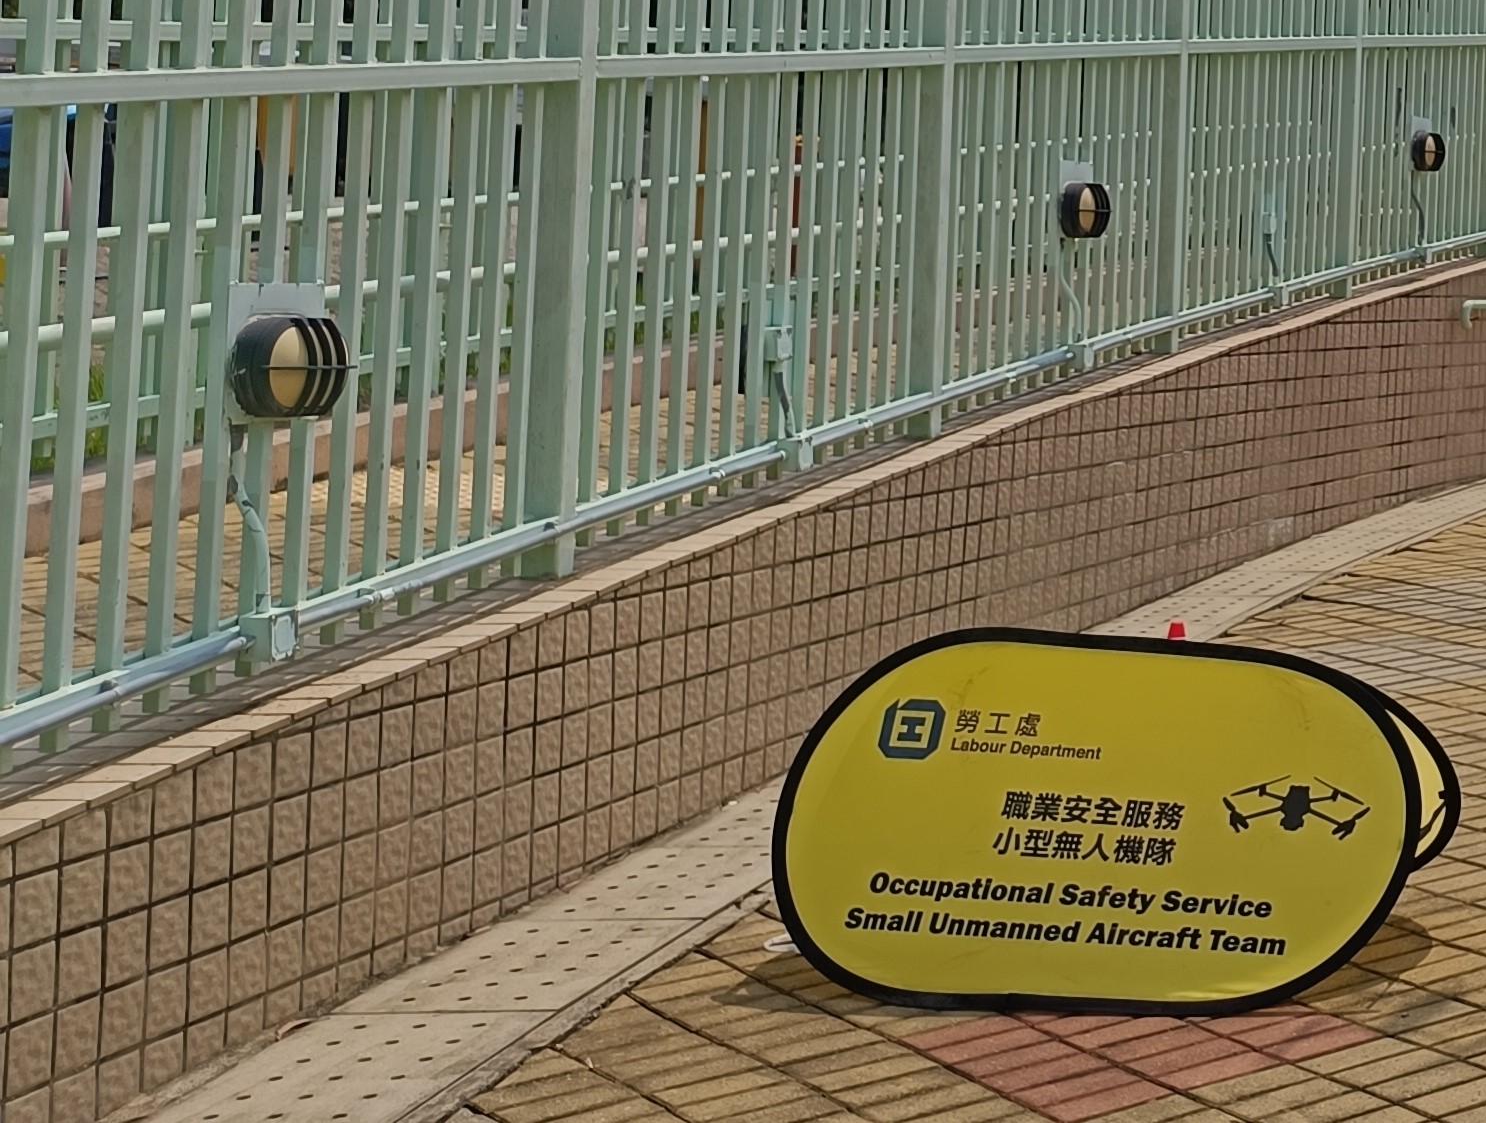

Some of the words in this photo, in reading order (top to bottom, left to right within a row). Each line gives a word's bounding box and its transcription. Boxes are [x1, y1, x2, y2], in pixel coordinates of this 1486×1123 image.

[953, 709, 1042, 737] 勞工處
[950, 737, 1007, 754] Labour
[1009, 741, 1102, 760] Department
[1000, 790, 1184, 830] 職業安全服務
[992, 827, 1176, 866] 小型無人機隊
[869, 871, 1052, 906] Occupational
[1058, 882, 1155, 917] Safety
[1160, 889, 1273, 919] Service
[843, 906, 922, 934] Small
[928, 912, 1080, 943] Unmanned
[1085, 920, 1201, 952] Aircraft
[1206, 930, 1287, 957] Team
